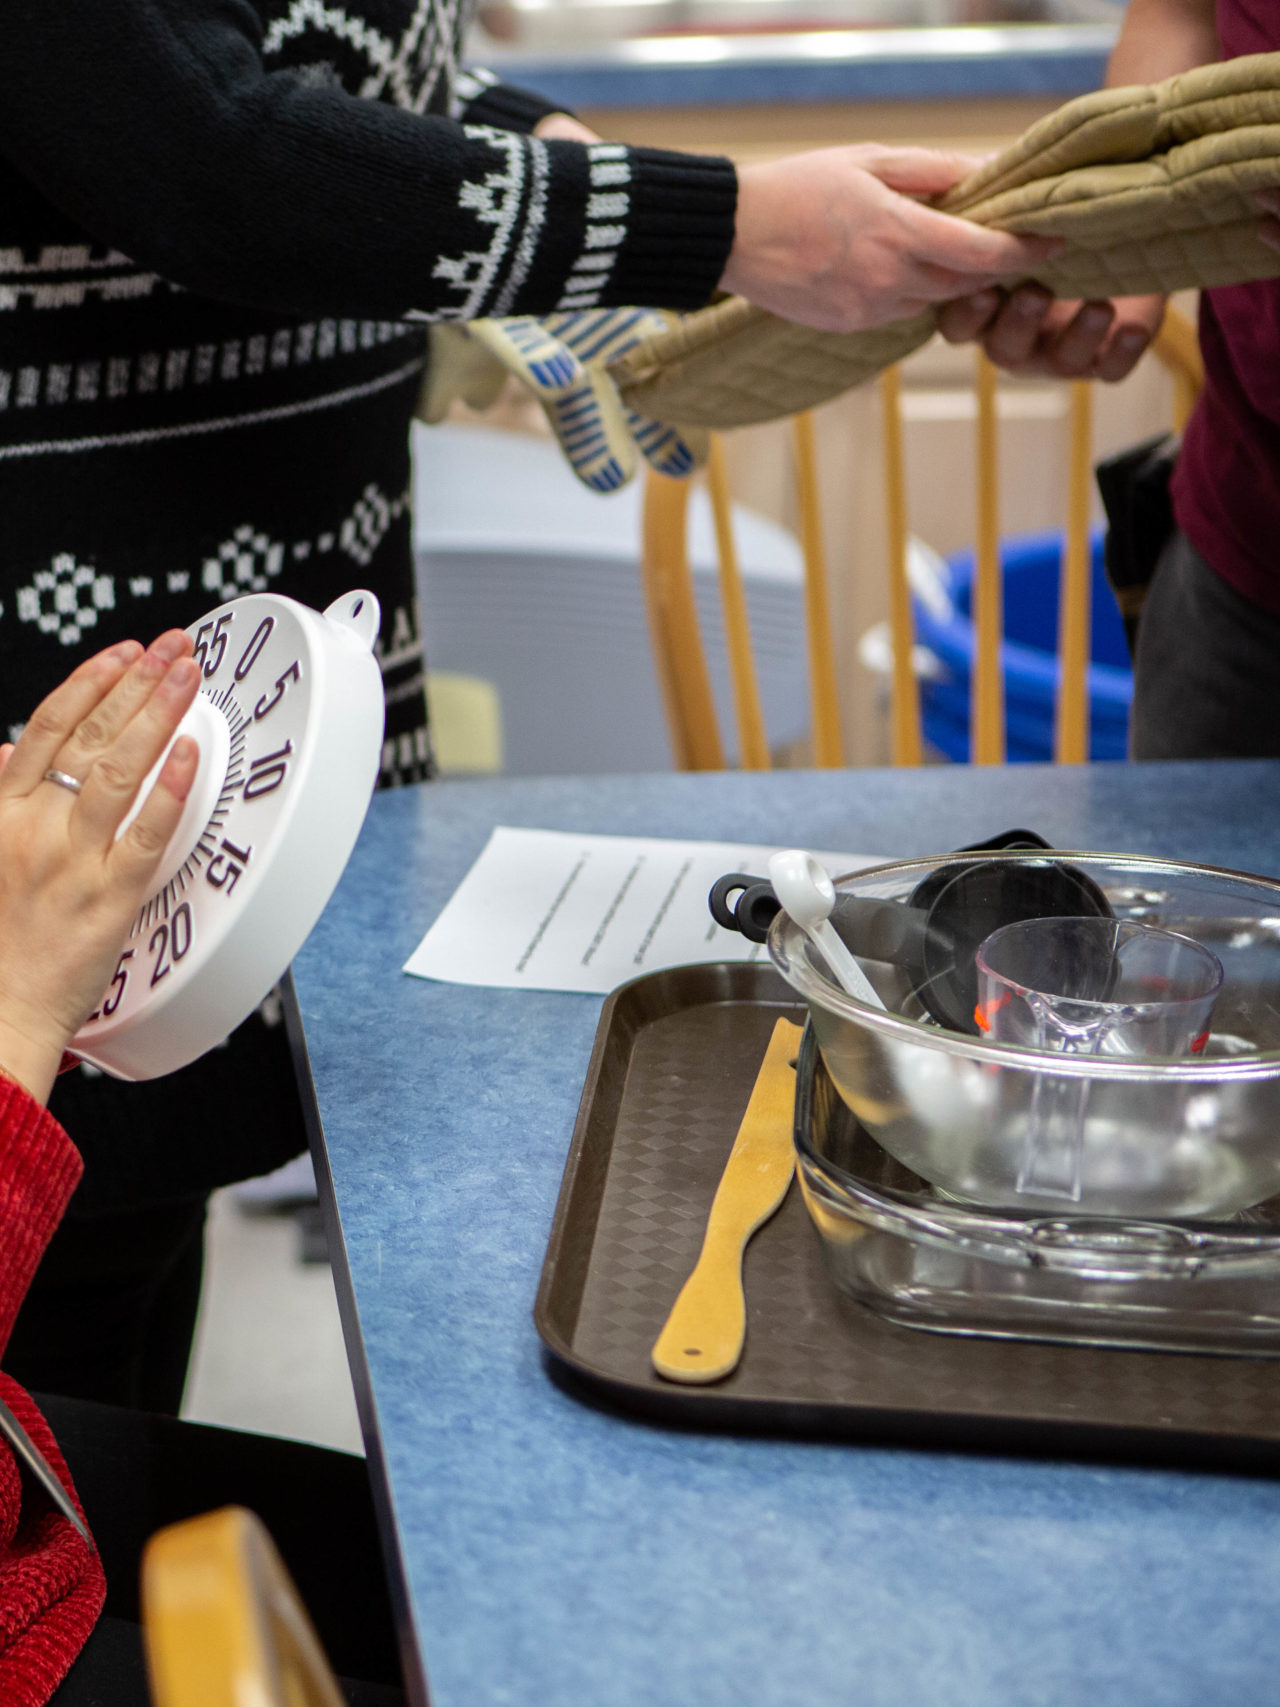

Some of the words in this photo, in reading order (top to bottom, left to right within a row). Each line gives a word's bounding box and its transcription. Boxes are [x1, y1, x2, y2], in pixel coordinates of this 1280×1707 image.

[193, 612, 234, 678] 55
[235, 617, 275, 681] 0
[254, 660, 301, 719] 5
[243, 739, 292, 801] 10
[206, 839, 251, 895] 15
[149, 902, 192, 988] 20
[86, 949, 135, 1021] 5
